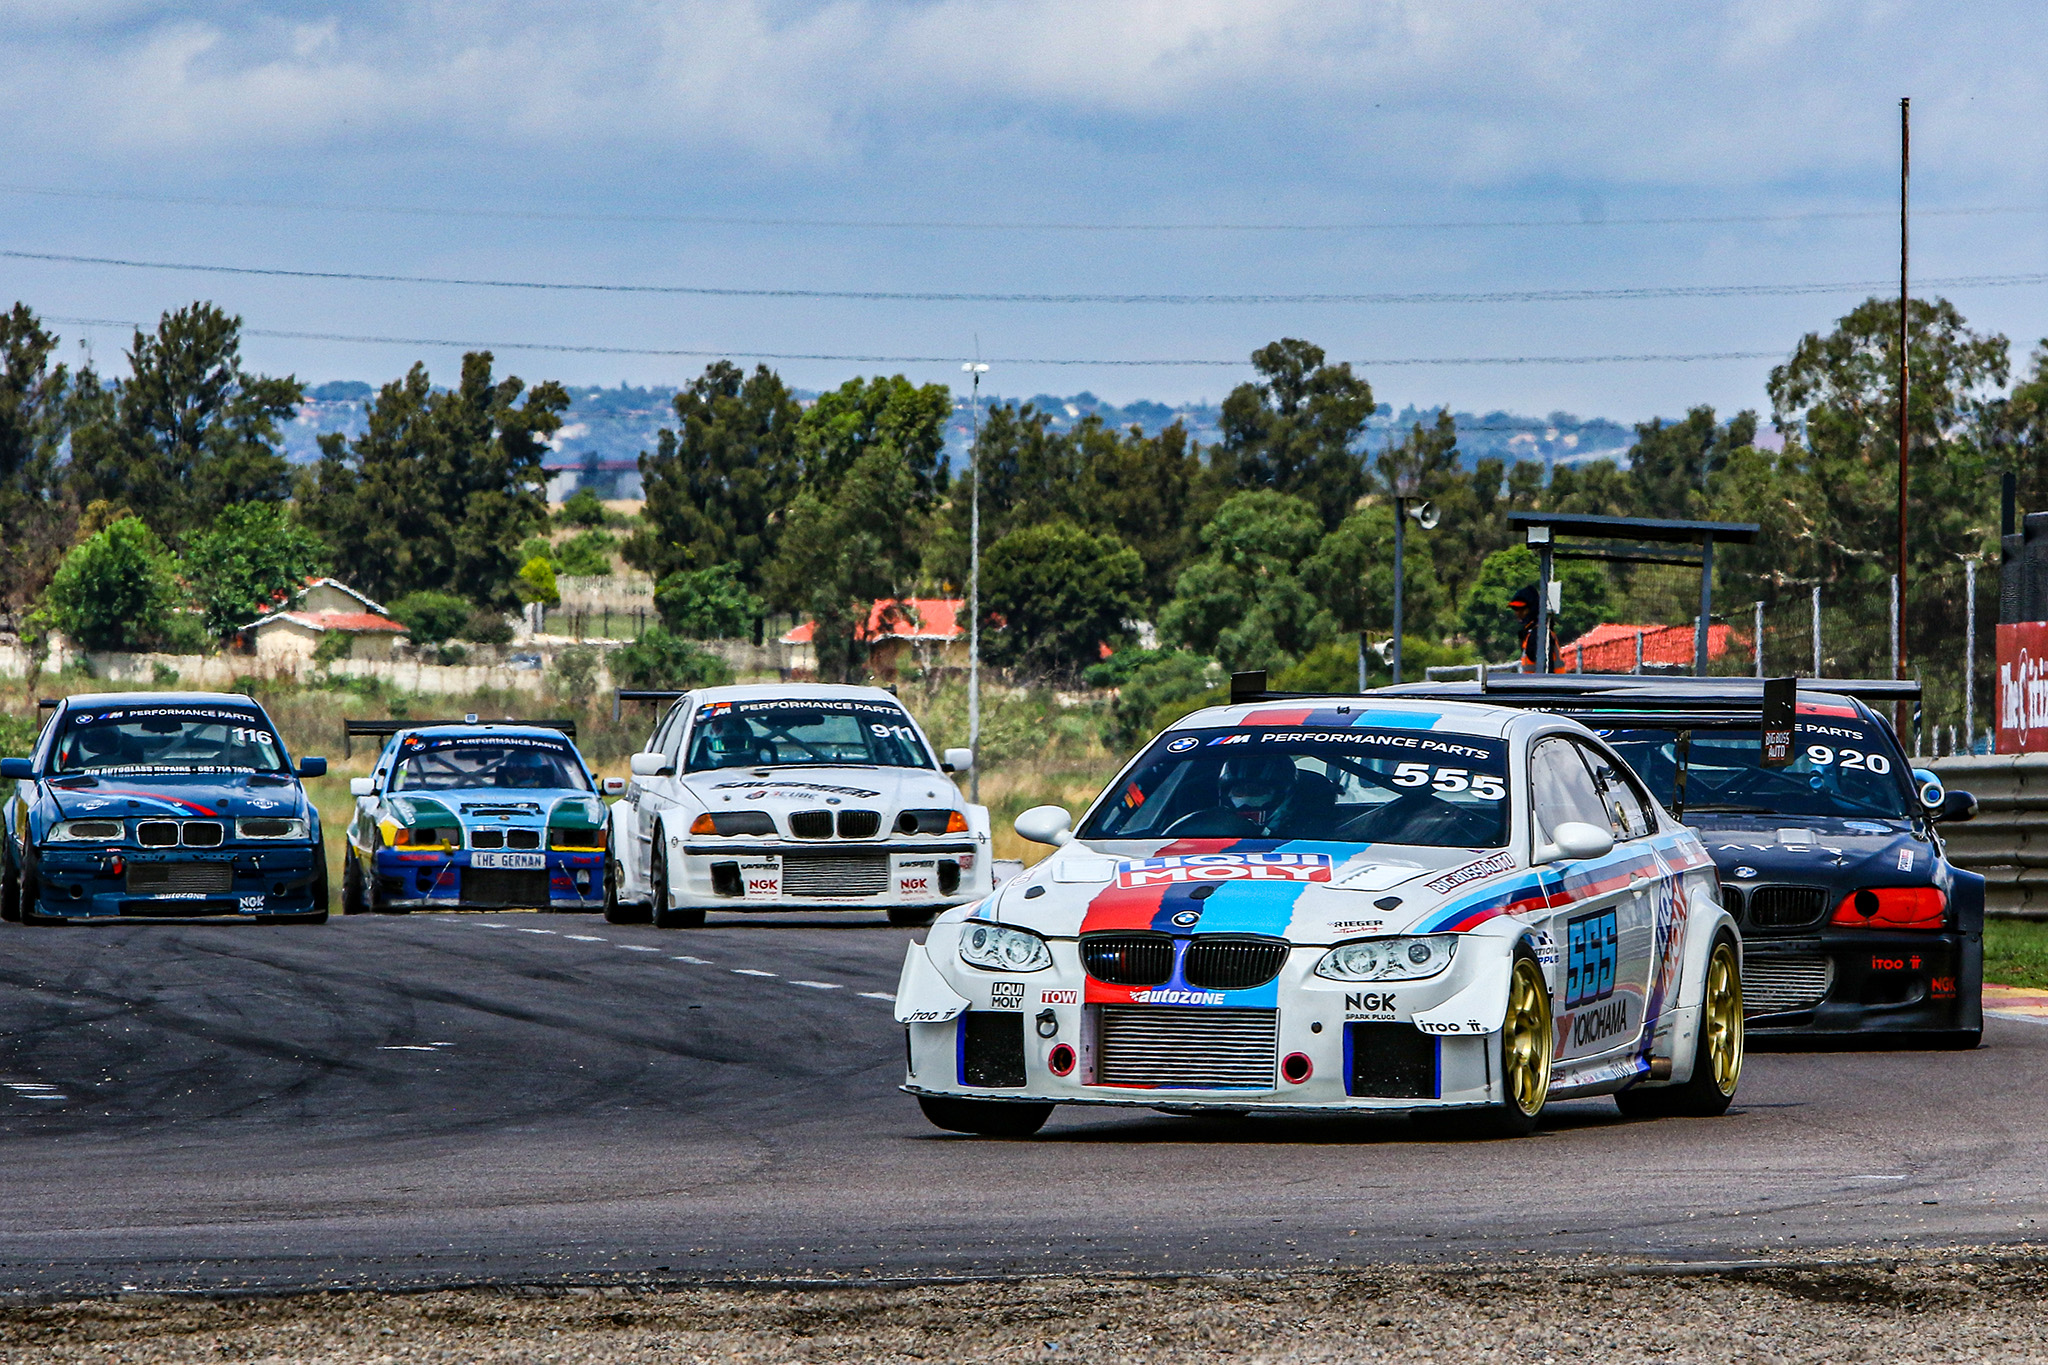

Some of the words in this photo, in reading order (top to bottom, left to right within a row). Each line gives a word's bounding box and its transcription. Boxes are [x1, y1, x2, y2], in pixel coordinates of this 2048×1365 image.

[740, 702, 851, 712] PERFORMANCE
[854, 703, 901, 715] PARTS
[218, 710, 255, 722] PARTS
[232, 727, 273, 745] 116
[870, 723, 916, 742] 911
[1806, 724, 1863, 740] PARTS
[457, 738, 531, 746] PERFORMANCE
[532, 741, 563, 751] PARTS
[1261, 733, 1418, 748] PERFORMANCE
[1421, 739, 1490, 760] PARTS
[1768, 745, 1785, 758] AUTO
[1806, 745, 1890, 775] 920
[1392, 763, 1506, 801] 555
[476, 854, 495, 867] THE
[501, 854, 541, 867] GERMAN
[1130, 854, 1318, 870] LIQUI
[1131, 866, 1327, 885] MOLY
[749, 879, 778, 890] NGK
[900, 878, 928, 890] NGK
[239, 895, 266, 908] NGK
[1334, 920, 1383, 928] RIEGER
[1566, 907, 1617, 1008] 555
[993, 983, 1023, 996] LIQUI
[1931, 976, 1956, 991] NGK
[991, 996, 1022, 1008] MOLY
[1042, 991, 1077, 1004] TOW
[1345, 993, 1397, 1012] NGK
[1574, 999, 1627, 1049] YOKOHAMA
